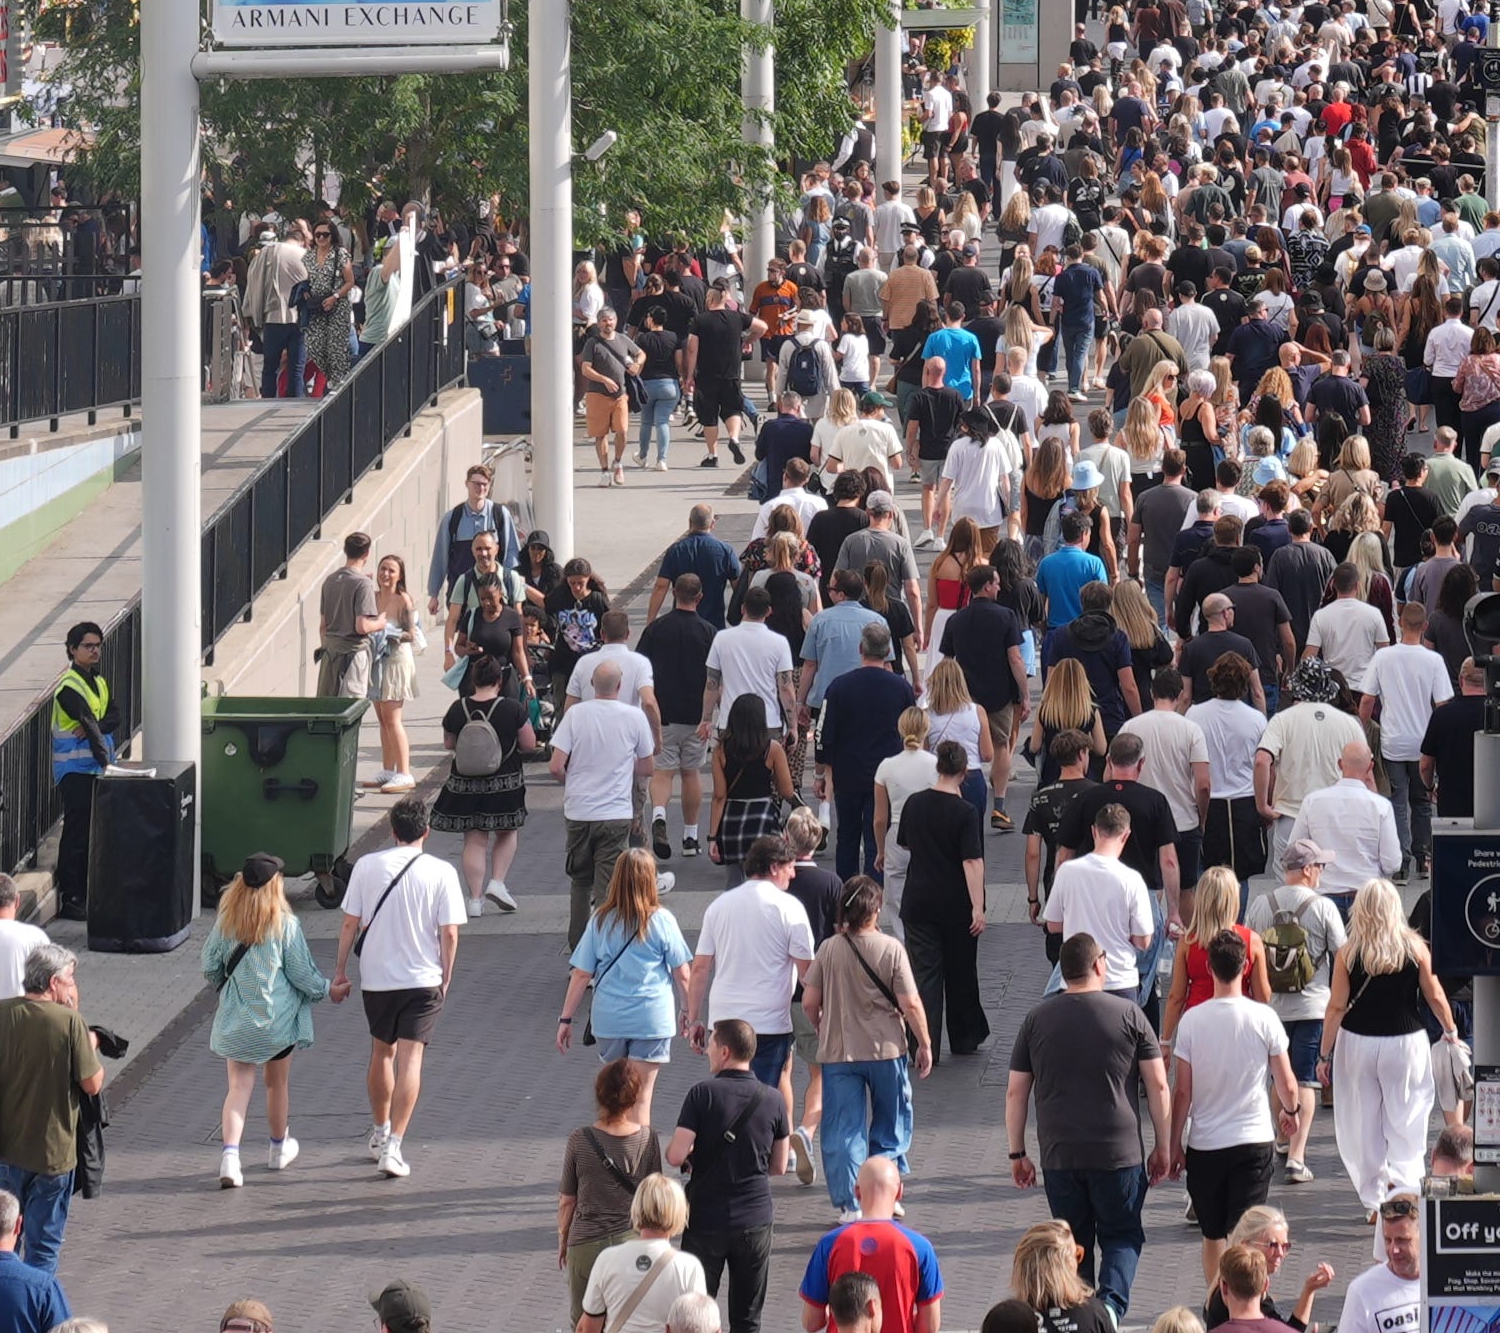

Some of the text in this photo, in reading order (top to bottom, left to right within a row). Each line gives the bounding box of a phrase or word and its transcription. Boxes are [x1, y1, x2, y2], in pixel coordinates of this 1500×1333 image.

[231, 5, 480, 28] ARMANI EXCHANGE
[1445, 1222, 1479, 1240] Off
